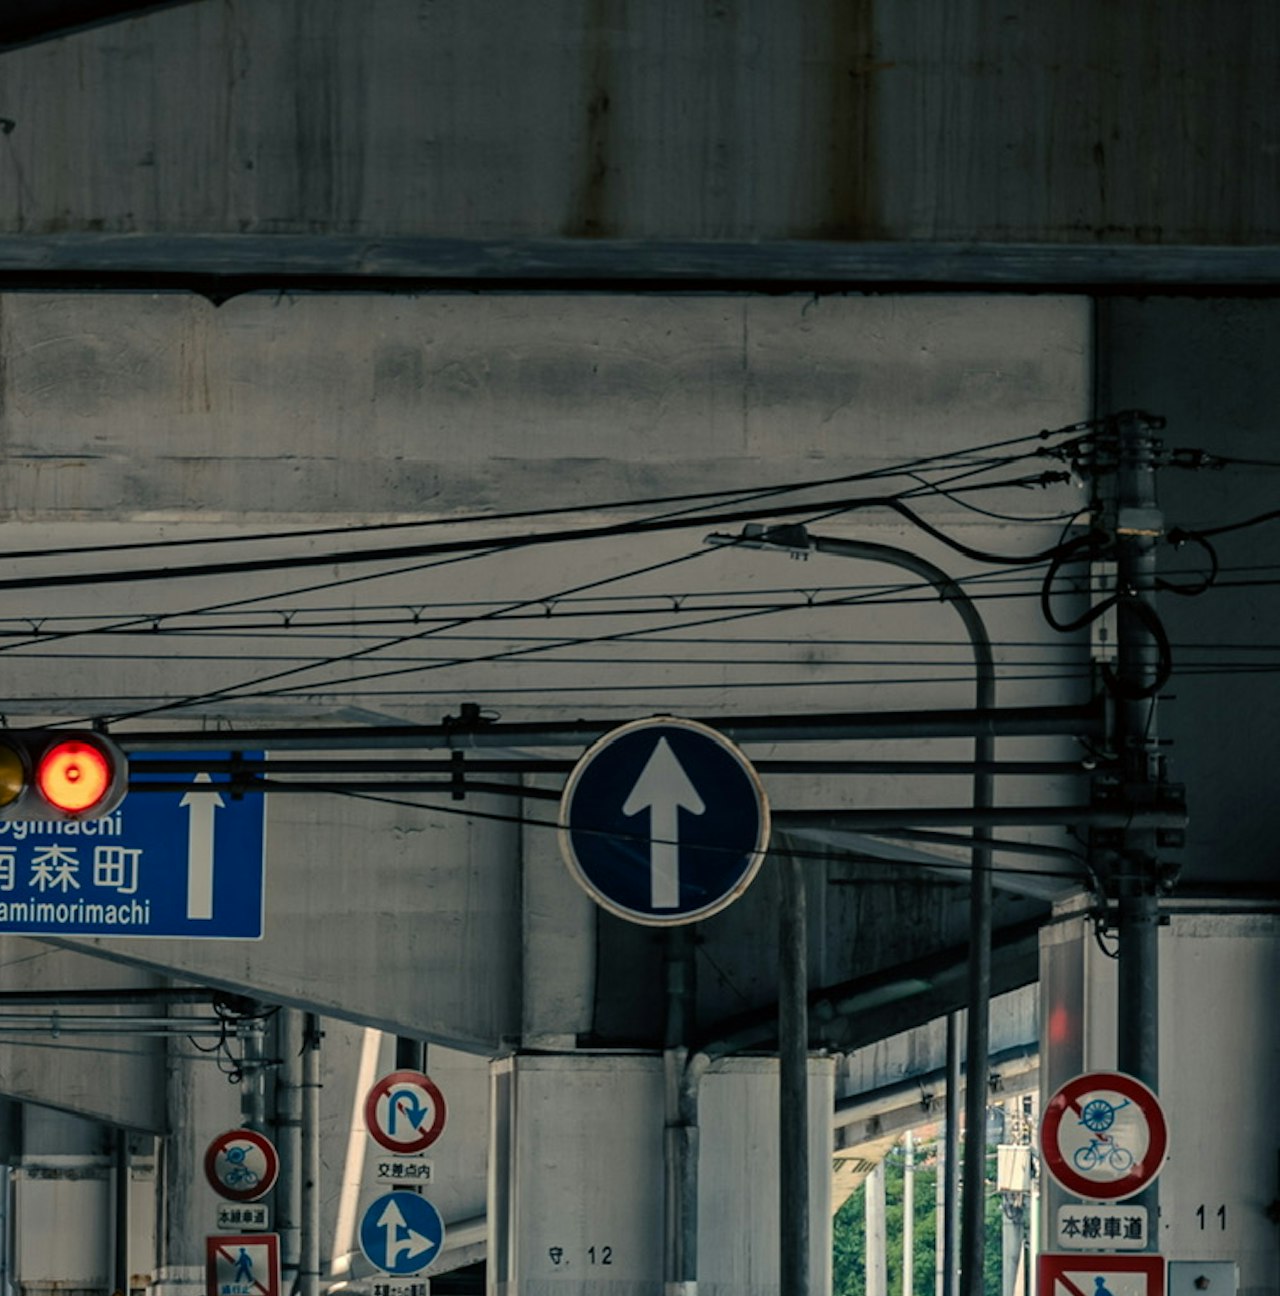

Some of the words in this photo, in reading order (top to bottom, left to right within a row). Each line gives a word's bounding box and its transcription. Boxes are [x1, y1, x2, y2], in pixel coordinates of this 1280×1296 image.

[378, 1162, 430, 1178] 交差点内
[1061, 1215, 1143, 1240] 本線車道
[1197, 1205, 1225, 1230] 11
[588, 1246, 611, 1265] 12
